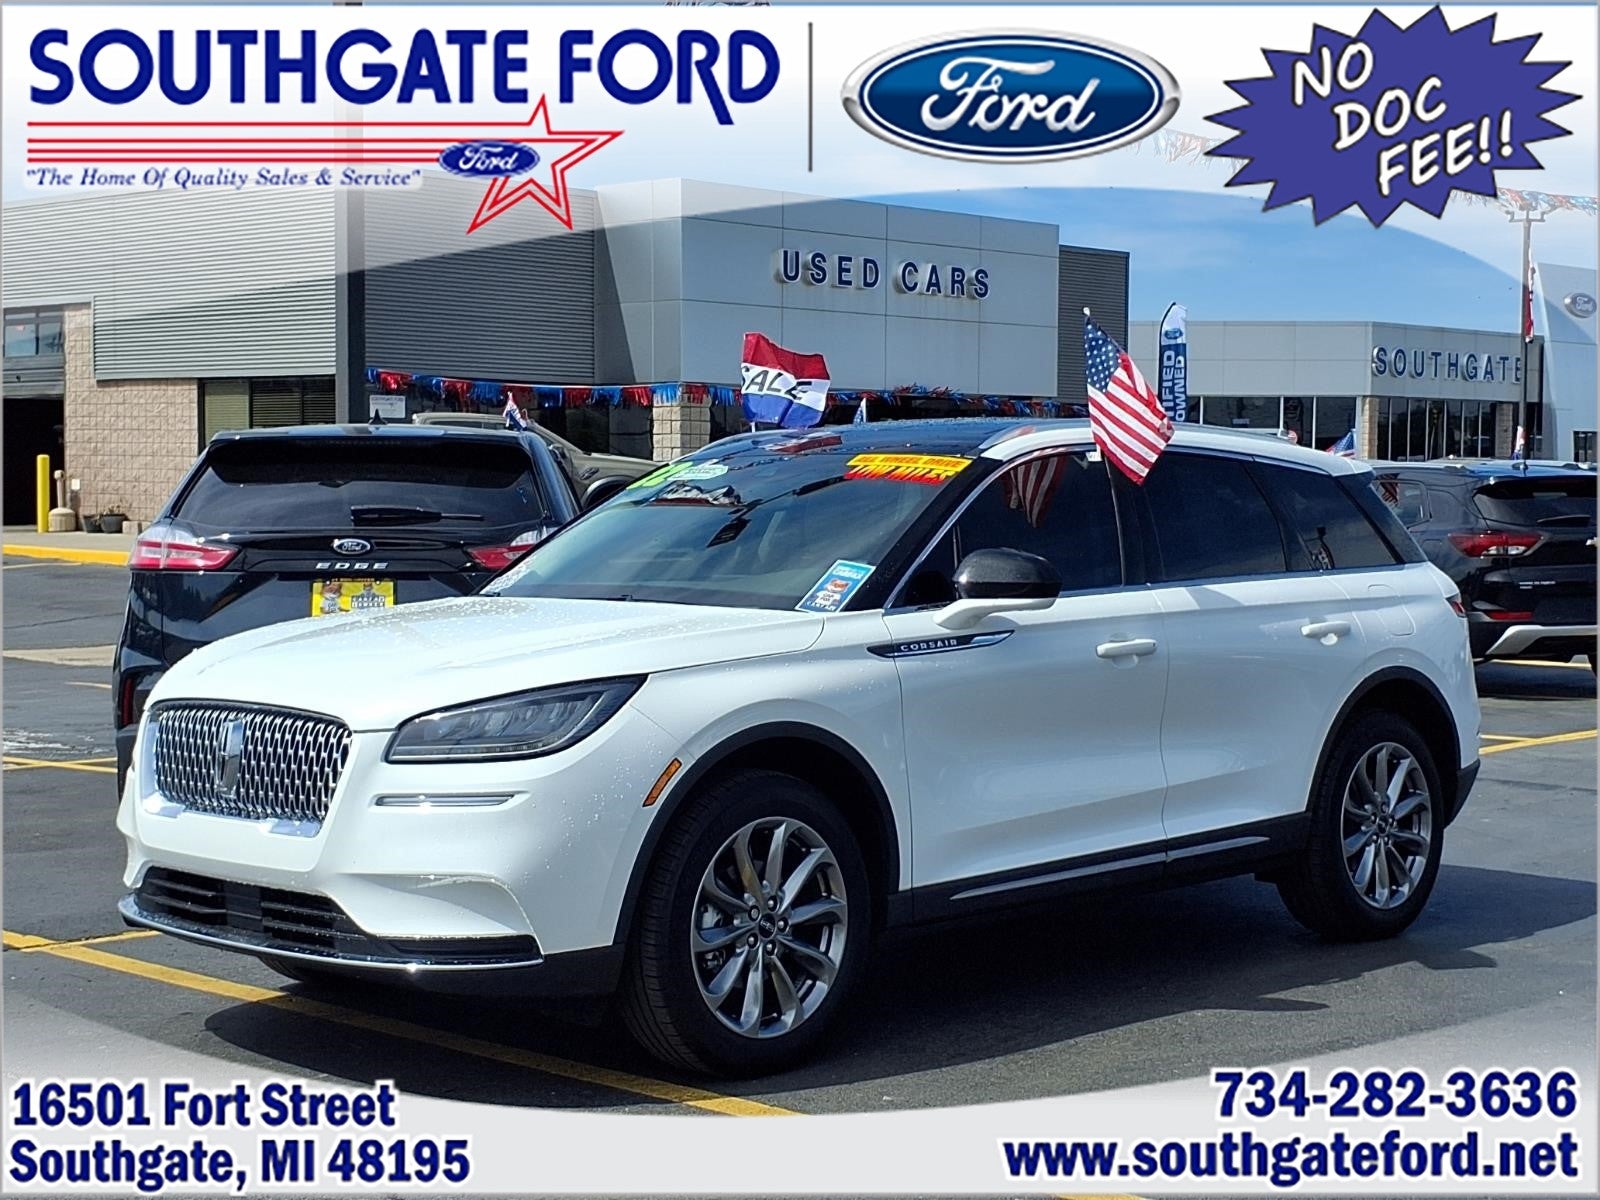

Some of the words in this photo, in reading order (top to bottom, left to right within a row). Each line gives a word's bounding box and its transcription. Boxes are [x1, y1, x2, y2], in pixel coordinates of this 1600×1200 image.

[782, 249, 881, 289] USED
[900, 261, 990, 299] CARS
[1373, 346, 1521, 384] SOUTHGATE
[1174, 355, 1186, 422] OWNED
[900, 638, 958, 652] CORSAIR
